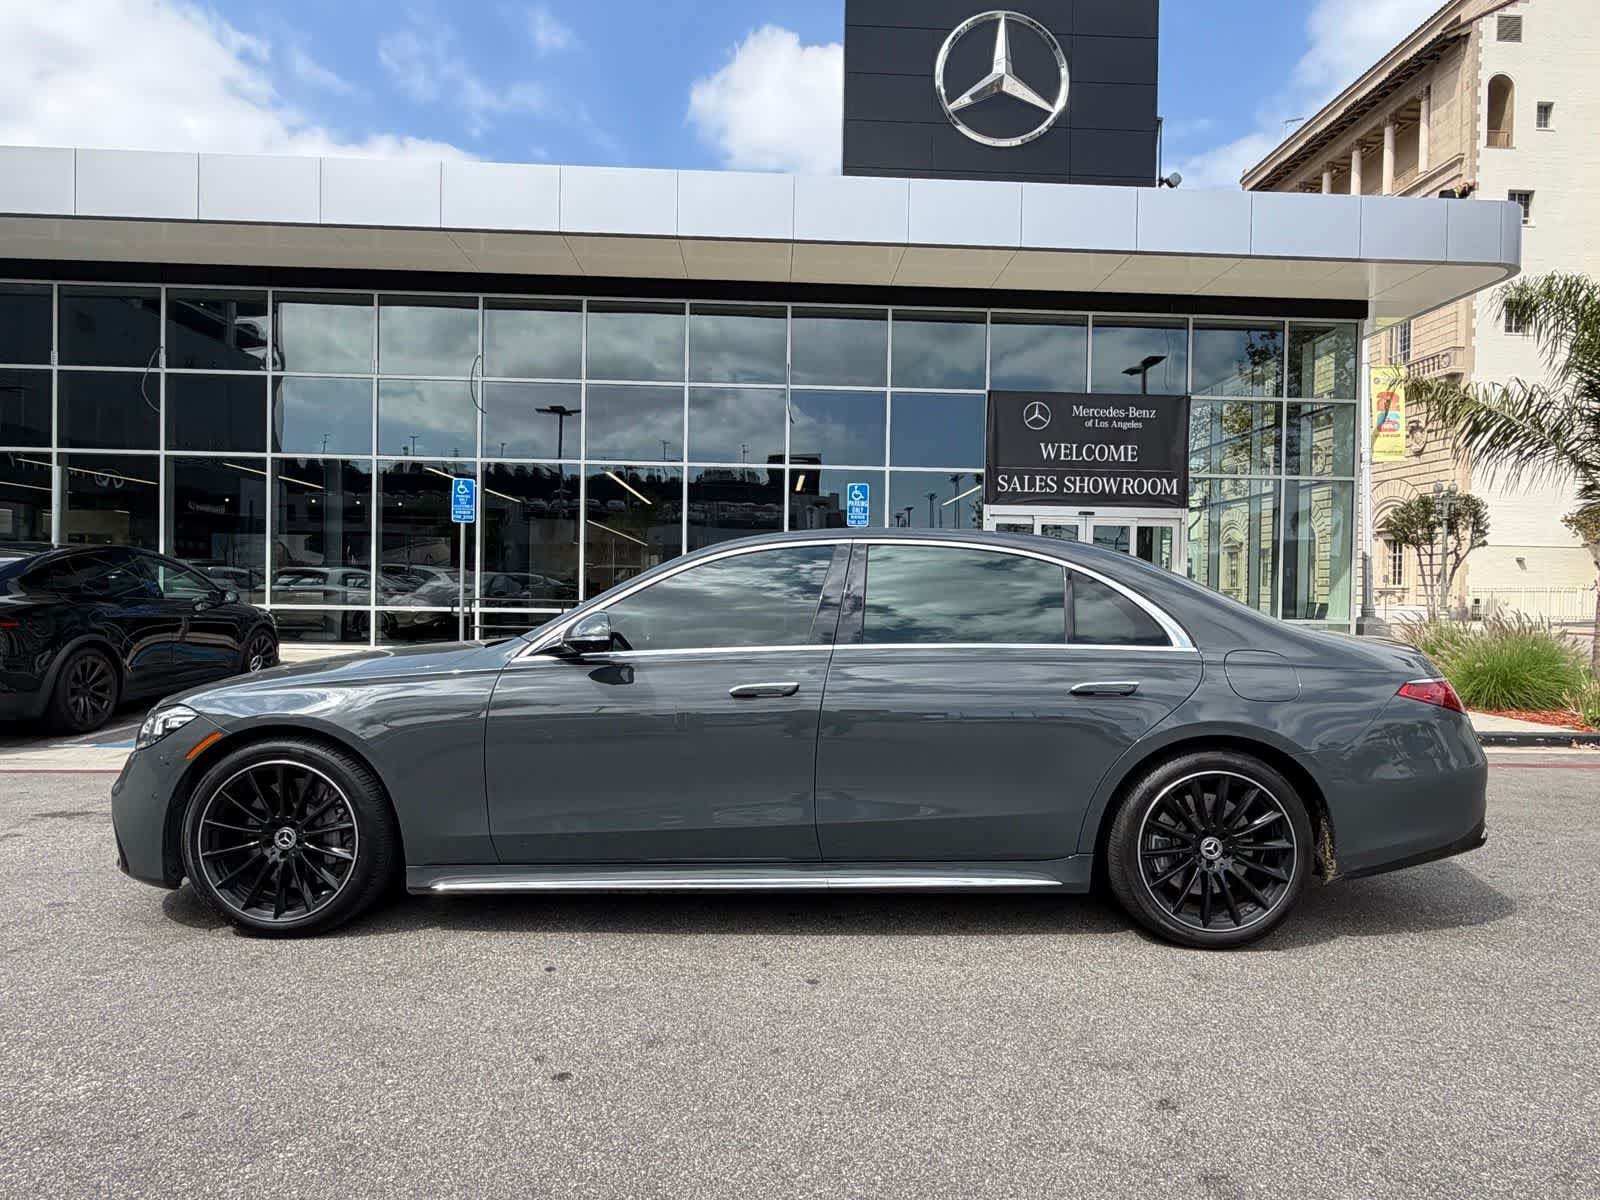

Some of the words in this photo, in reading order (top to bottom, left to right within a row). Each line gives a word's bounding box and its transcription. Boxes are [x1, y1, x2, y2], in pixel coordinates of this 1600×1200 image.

[1072, 405, 1156, 419] Mercedes-Benz
[1084, 420, 1093, 428] of
[1095, 420, 1109, 428] Los
[1111, 420, 1143, 430] Angeles
[1040, 442, 1138, 462] WELCOME
[997, 474, 1057, 493] SALES
[1063, 476, 1178, 495] SHOWROOM
